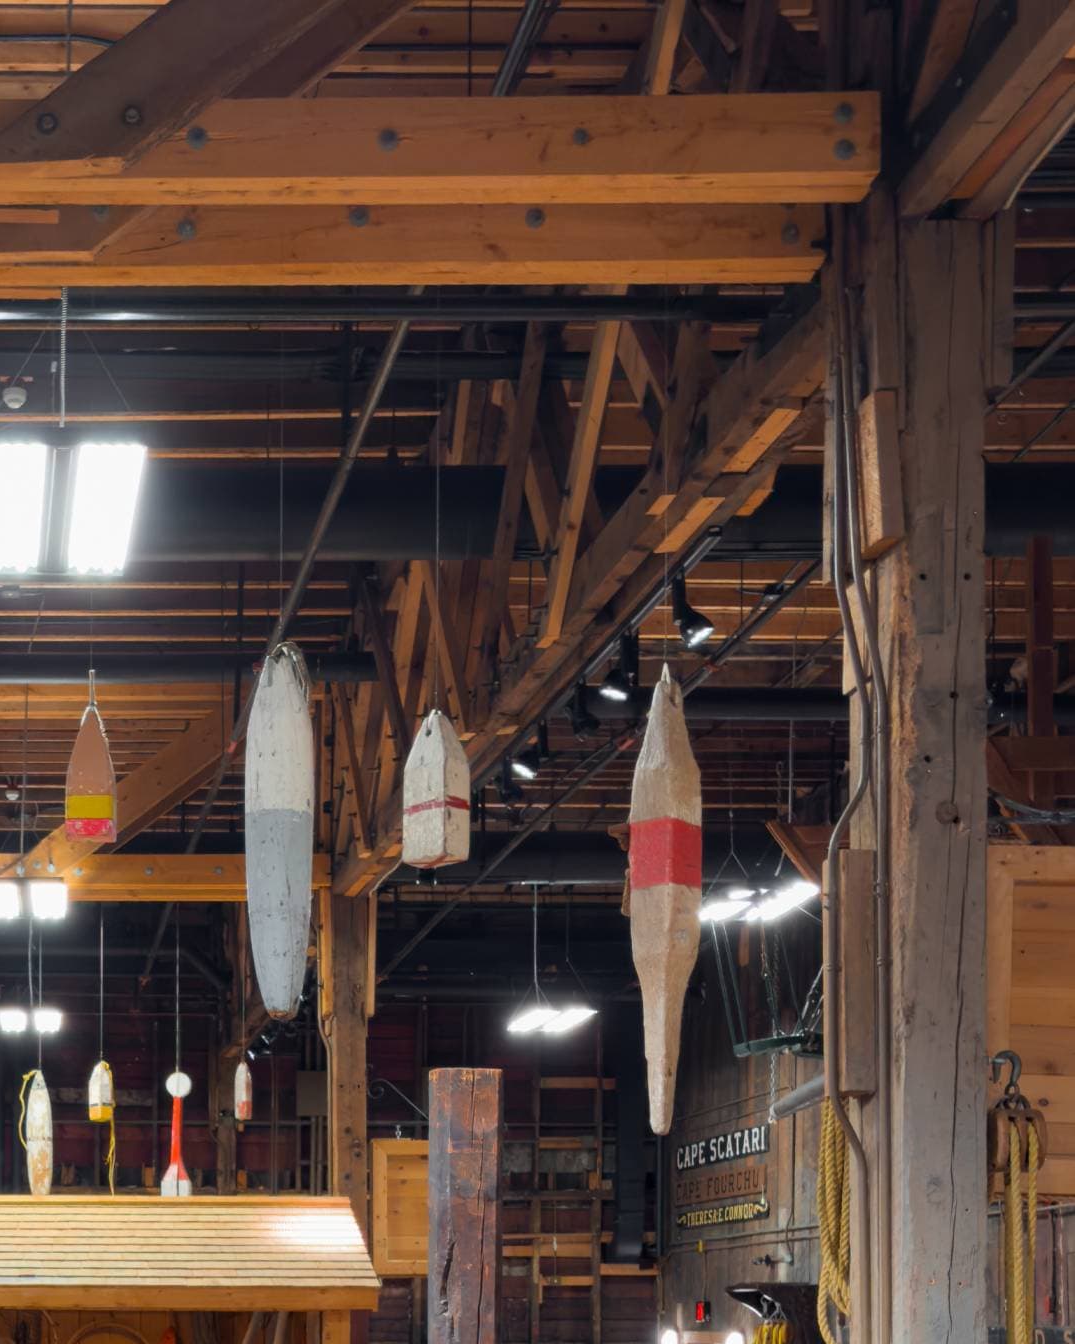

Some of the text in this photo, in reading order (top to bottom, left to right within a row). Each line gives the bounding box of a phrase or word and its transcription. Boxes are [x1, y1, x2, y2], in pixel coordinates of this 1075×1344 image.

[677, 1126, 766, 1170] CAPE SCATARI
[676, 1170, 759, 1201] CAPE FOURCHU
[725, 1203, 754, 1221] CONNOR
